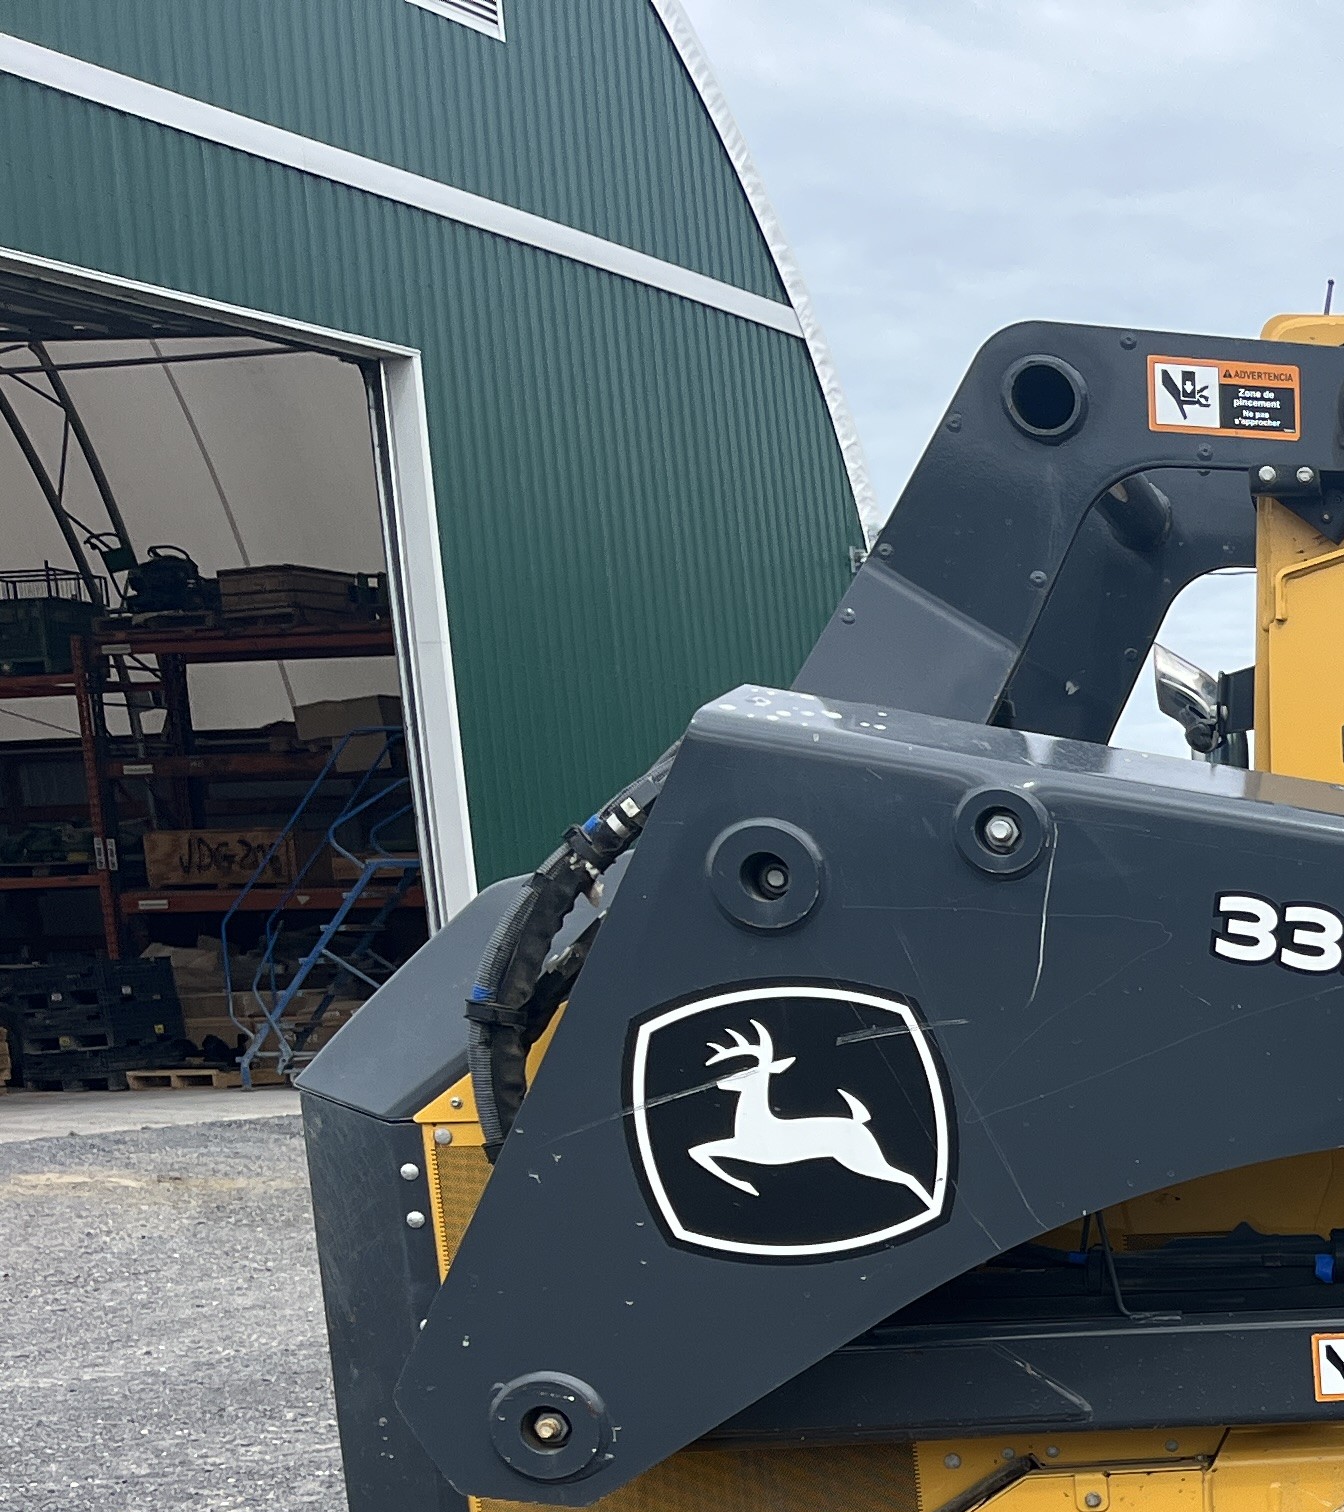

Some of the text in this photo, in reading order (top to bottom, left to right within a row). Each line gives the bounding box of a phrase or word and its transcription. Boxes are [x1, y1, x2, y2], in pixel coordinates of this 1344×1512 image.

[1233, 371, 1294, 382] ADVERTENCIA
[1238, 388, 1275, 399] Zone de
[1233, 398, 1281, 408] pincement
[1242, 409, 1254, 417] Ne
